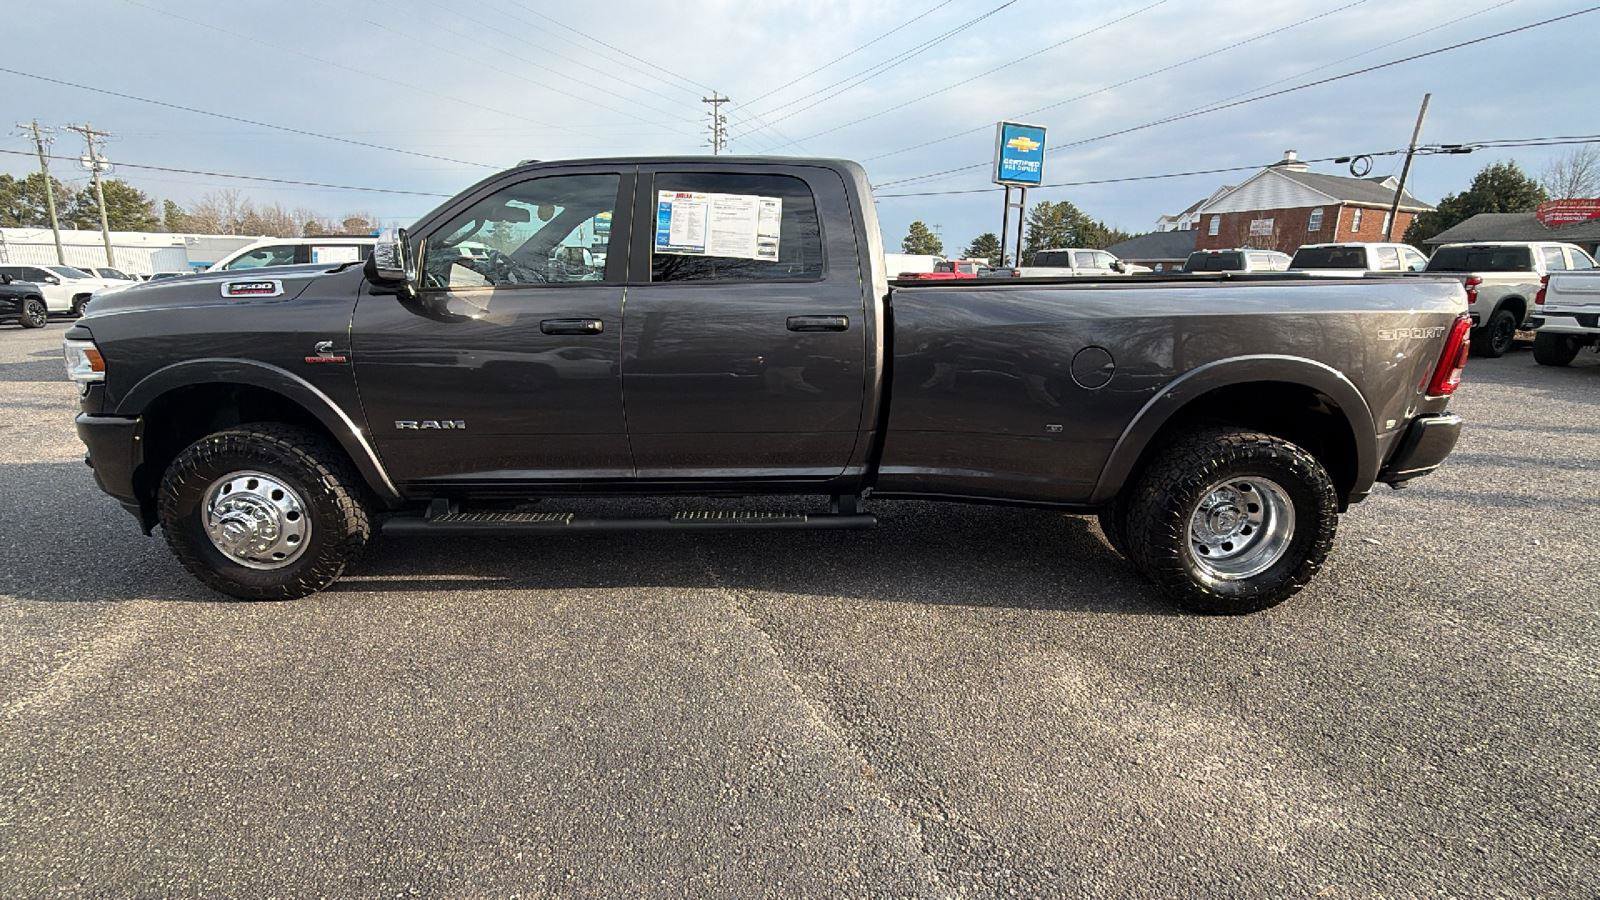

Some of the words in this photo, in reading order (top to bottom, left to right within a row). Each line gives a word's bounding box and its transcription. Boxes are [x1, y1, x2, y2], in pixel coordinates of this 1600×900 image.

[1003, 158, 1041, 168] CERTIFIED
[1377, 326, 1446, 341] SPORT
[394, 420, 466, 430] RAM
